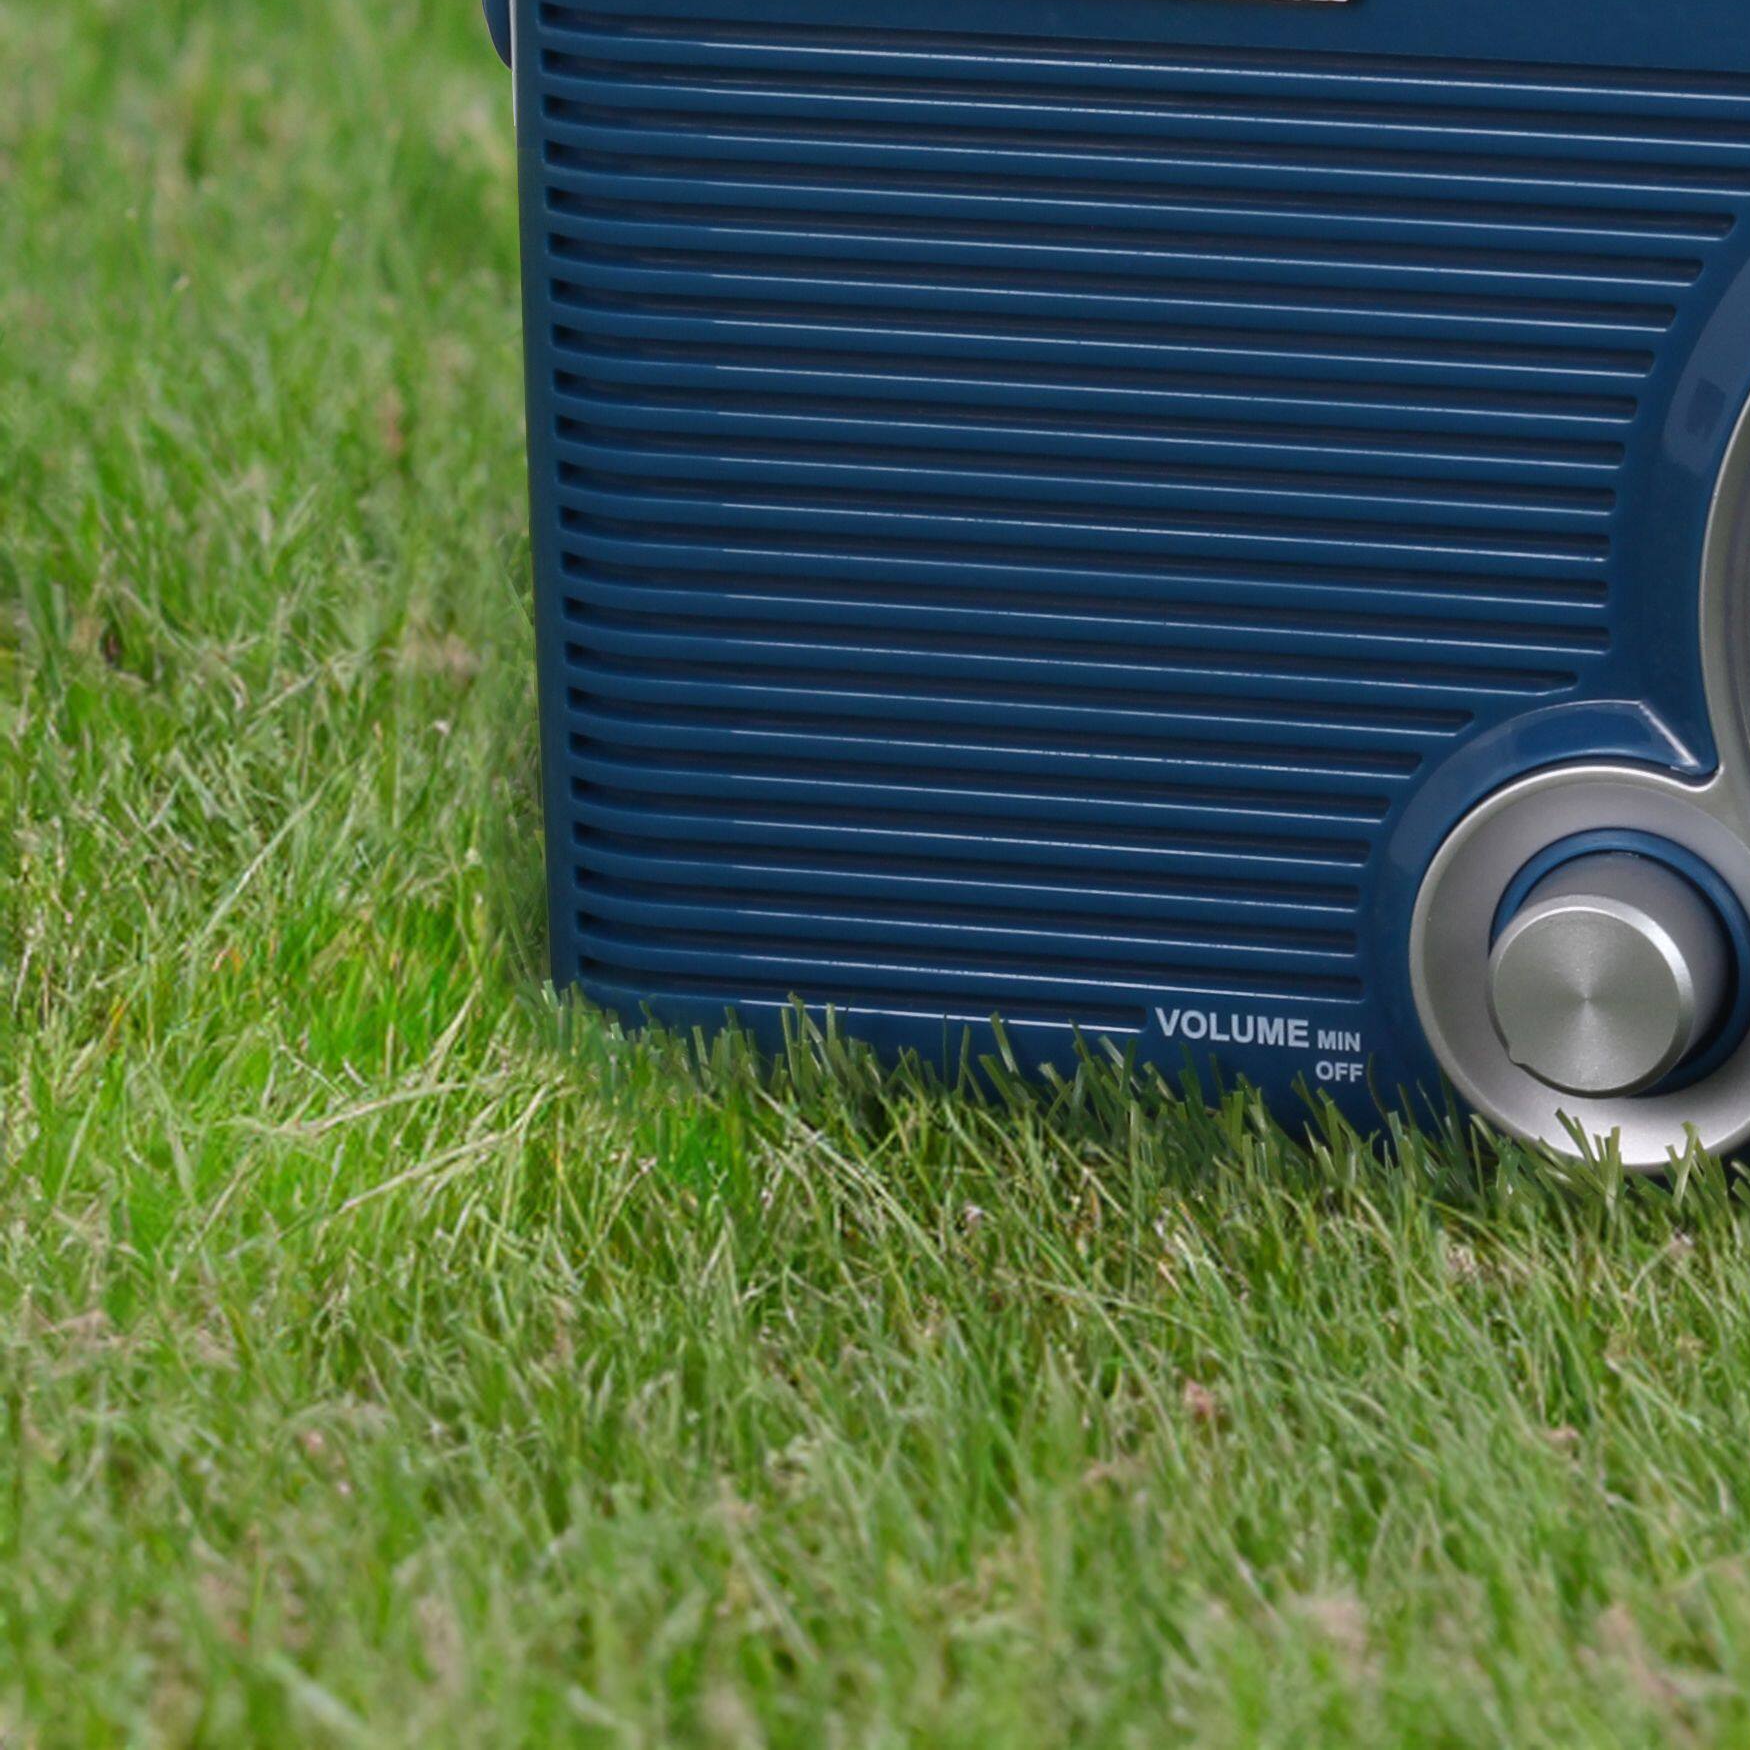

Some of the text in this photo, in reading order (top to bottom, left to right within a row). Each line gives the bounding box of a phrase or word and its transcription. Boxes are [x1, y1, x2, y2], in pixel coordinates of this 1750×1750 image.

[1154, 1007, 1361, 1053] VOLUME MIN
[1315, 1059, 1364, 1084] OFF
